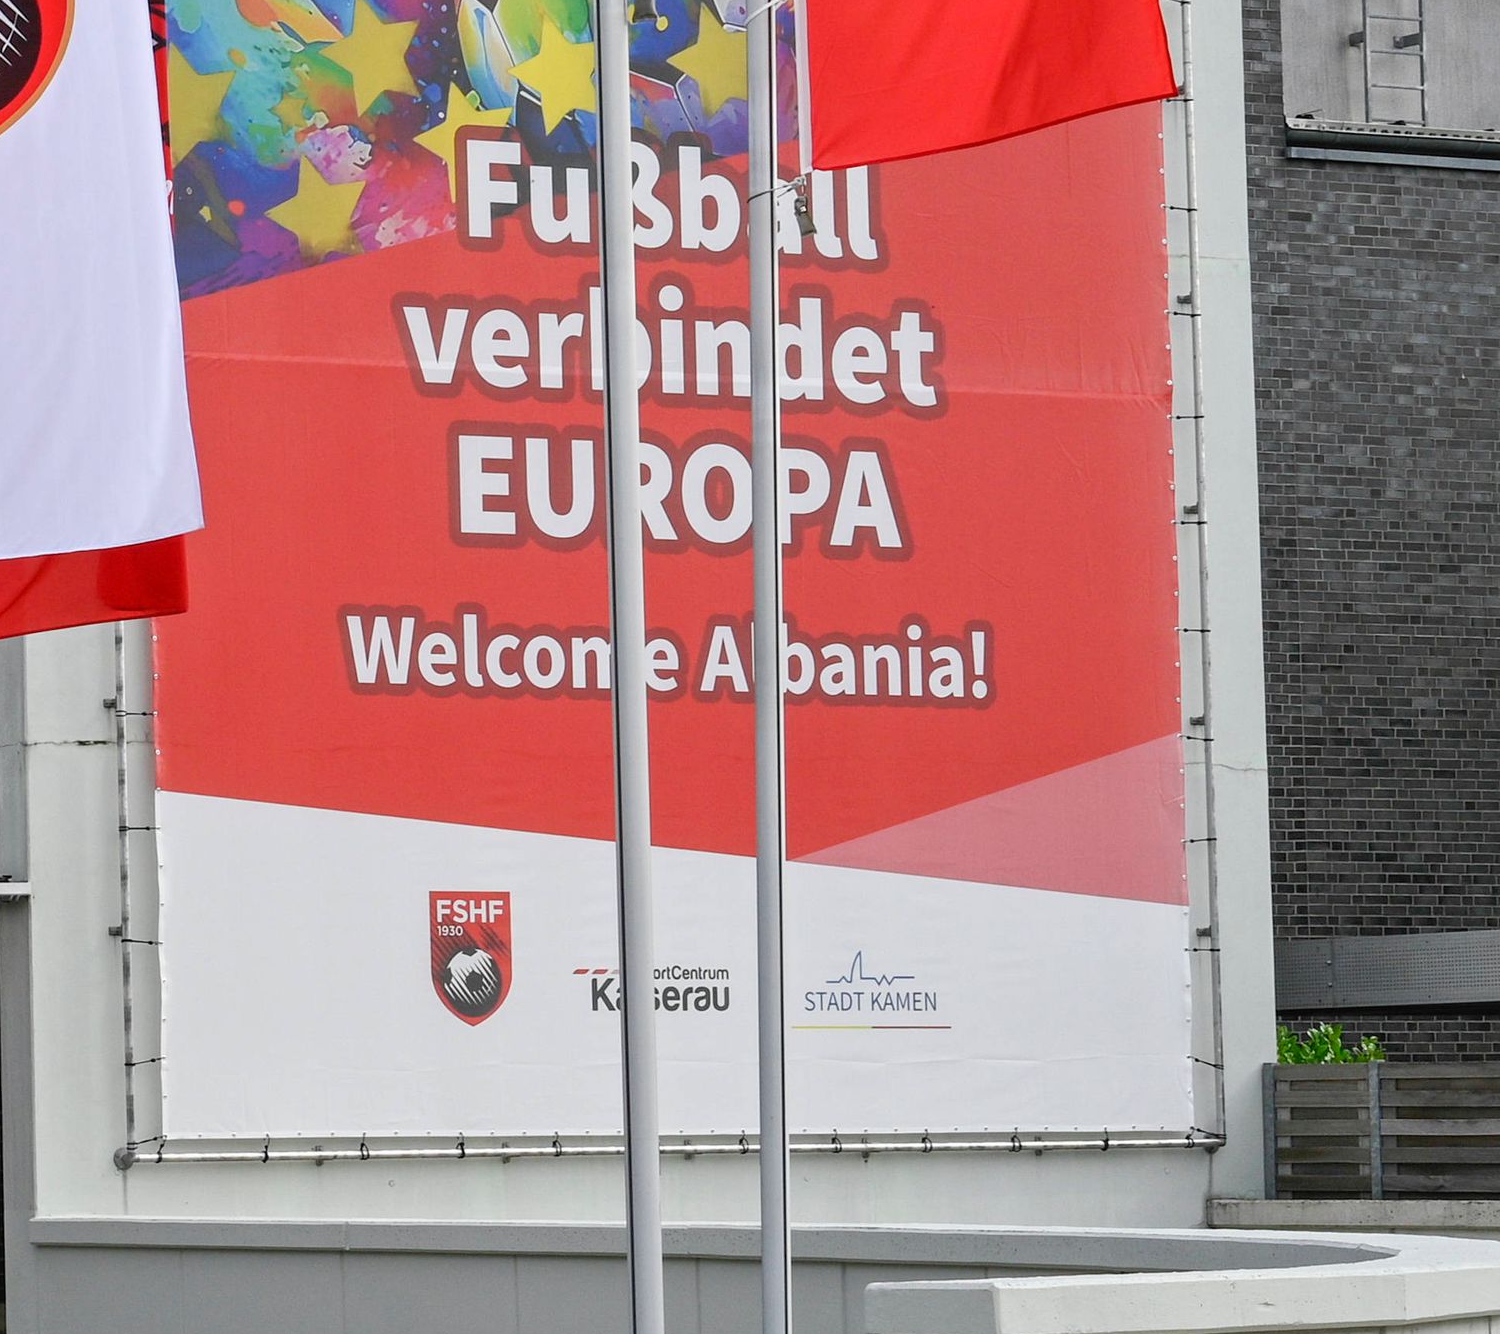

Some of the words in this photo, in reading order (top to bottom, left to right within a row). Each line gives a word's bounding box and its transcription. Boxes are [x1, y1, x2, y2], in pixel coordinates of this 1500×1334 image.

[457, 434, 902, 548] EUROPA
[345, 613, 680, 692] Welcome
[700, 624, 990, 700] Abania!
[436, 899, 504, 923] FSHF
[437, 926, 463, 936] 1930
[653, 965, 729, 981] ortCentrum
[592, 978, 730, 1012] Kserau
[804, 992, 865, 1013] STADT
[870, 992, 938, 1013] KAMEN
